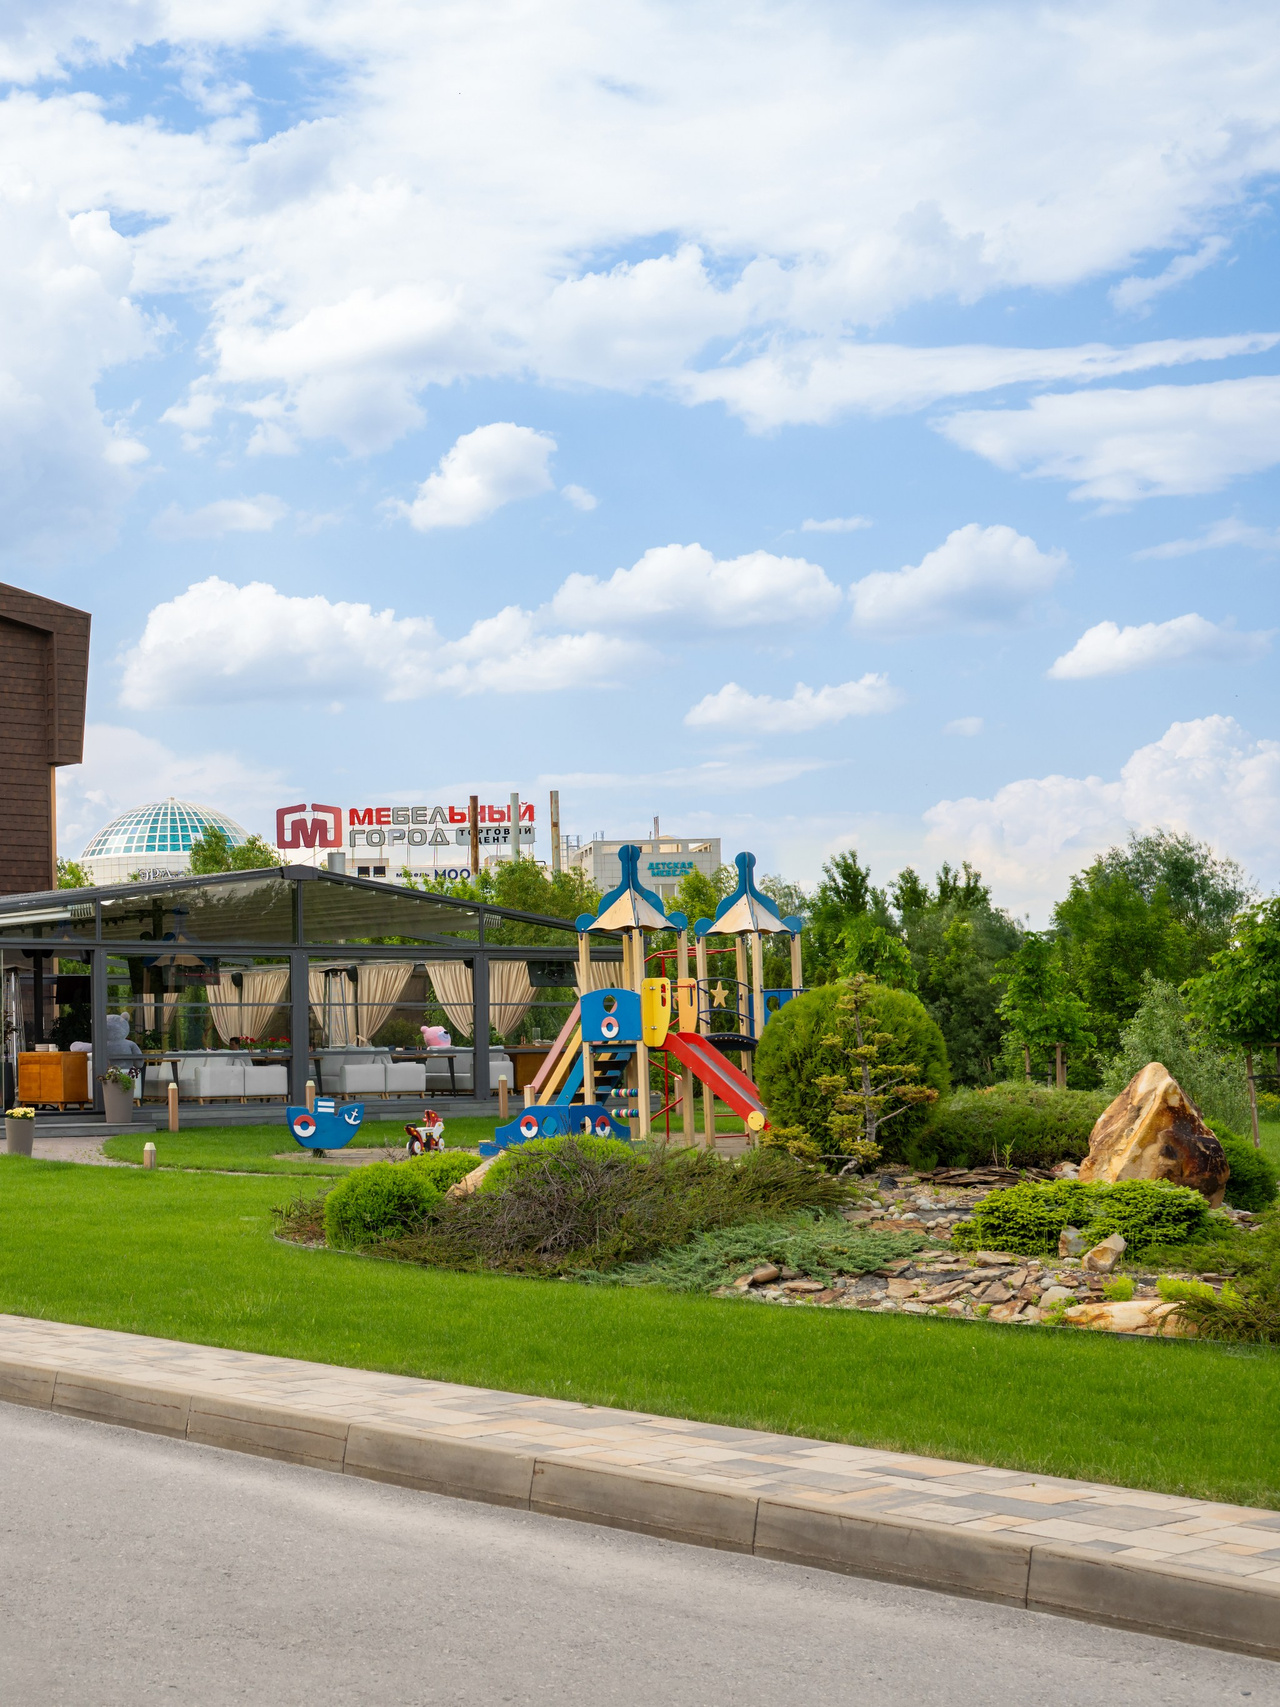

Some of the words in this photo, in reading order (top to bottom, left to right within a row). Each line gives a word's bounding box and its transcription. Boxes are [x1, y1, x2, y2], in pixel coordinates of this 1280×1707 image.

[349, 828, 450, 847] ГОРОД
[647, 861, 694, 870] ДЕТСКАЯ
[651, 869, 691, 877] МЕБЕЛЬ
